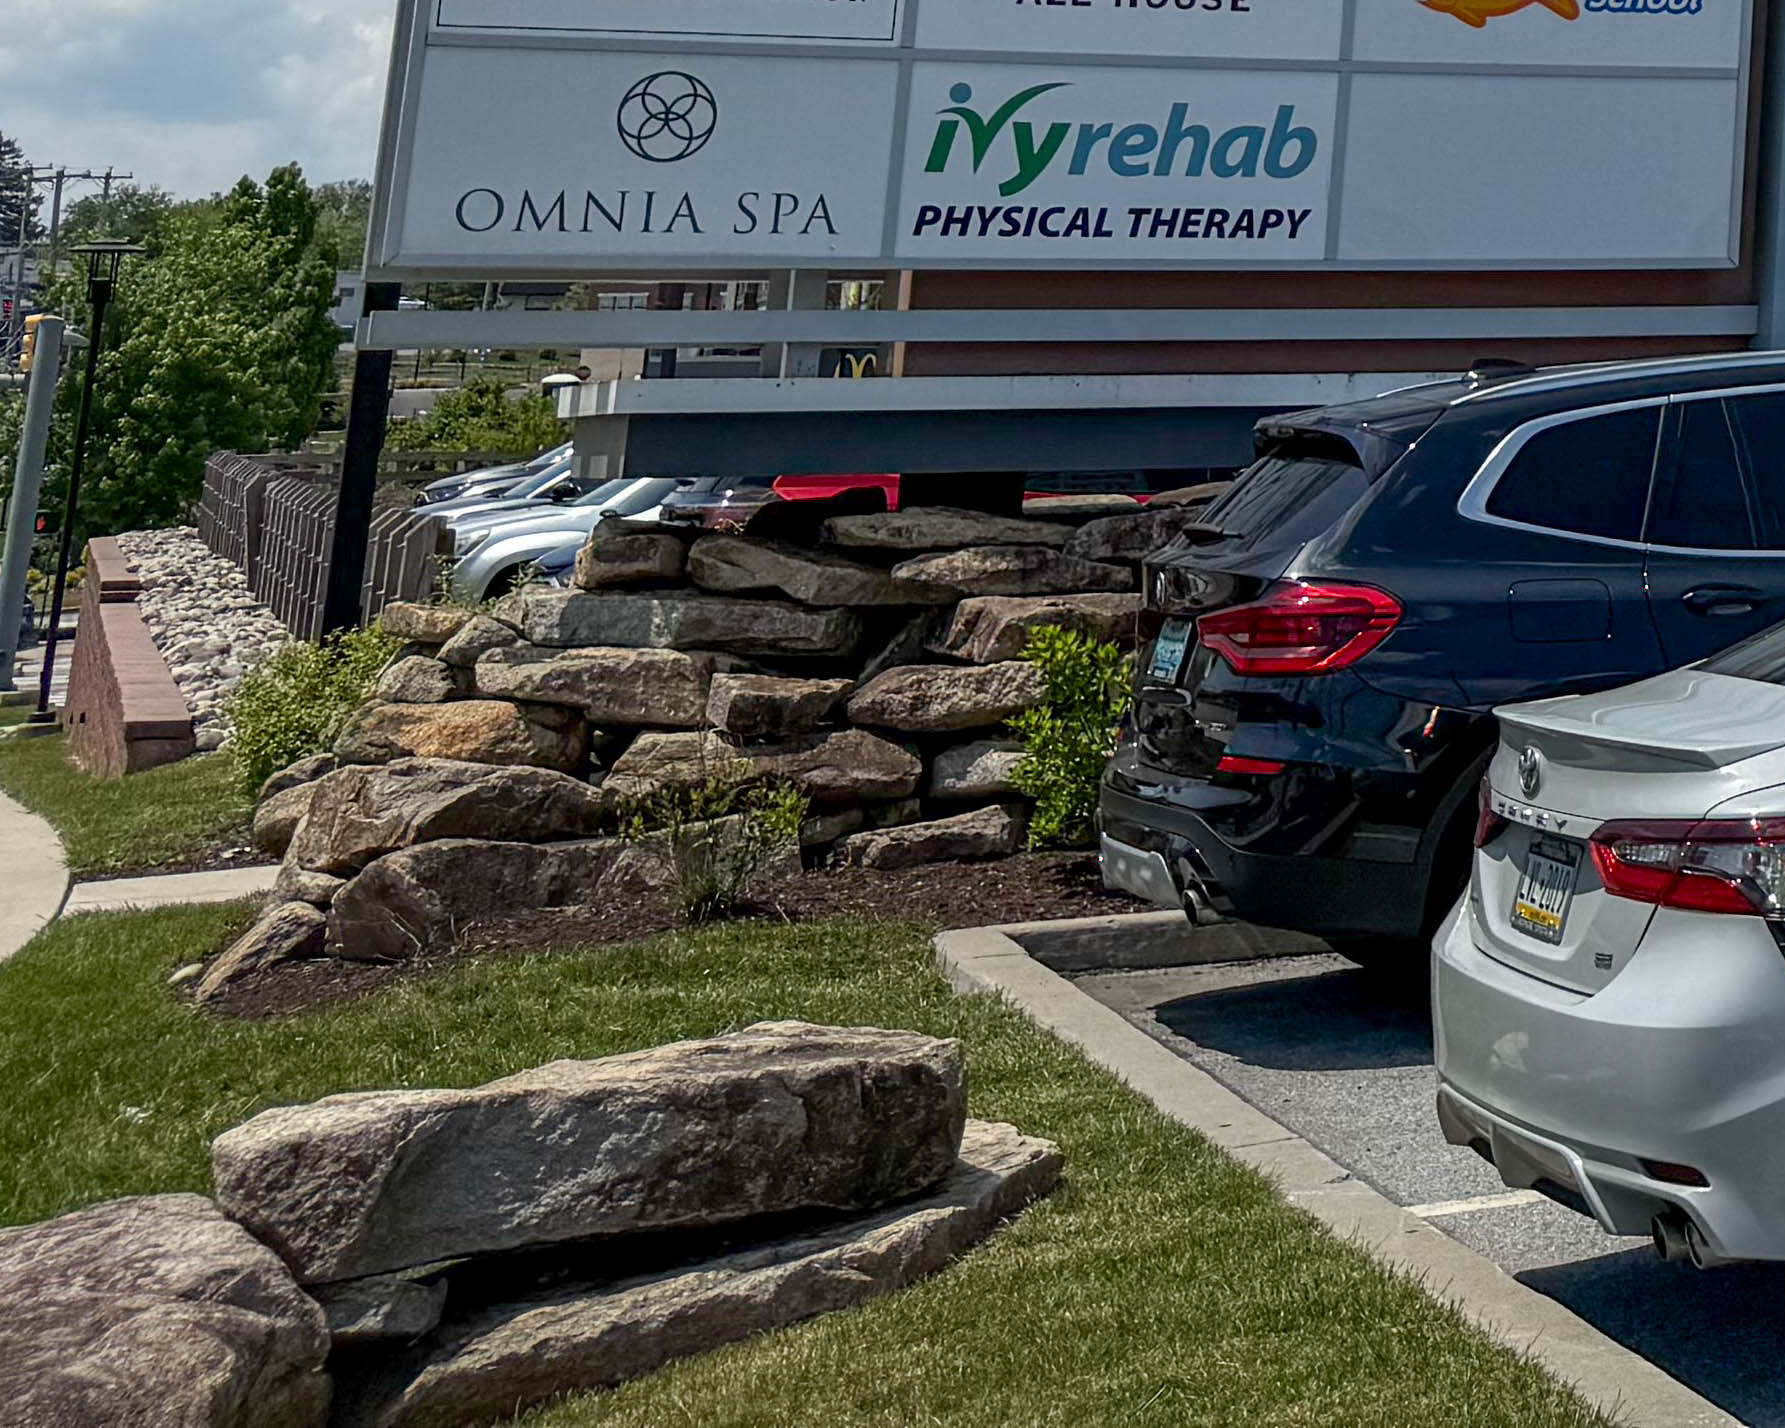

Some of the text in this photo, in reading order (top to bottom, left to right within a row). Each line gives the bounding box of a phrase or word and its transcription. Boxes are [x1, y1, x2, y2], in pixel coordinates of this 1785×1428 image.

[454, 187, 840, 236] OMNIA SPA
[911, 204, 1313, 240] PHYSICAL THERAPY
